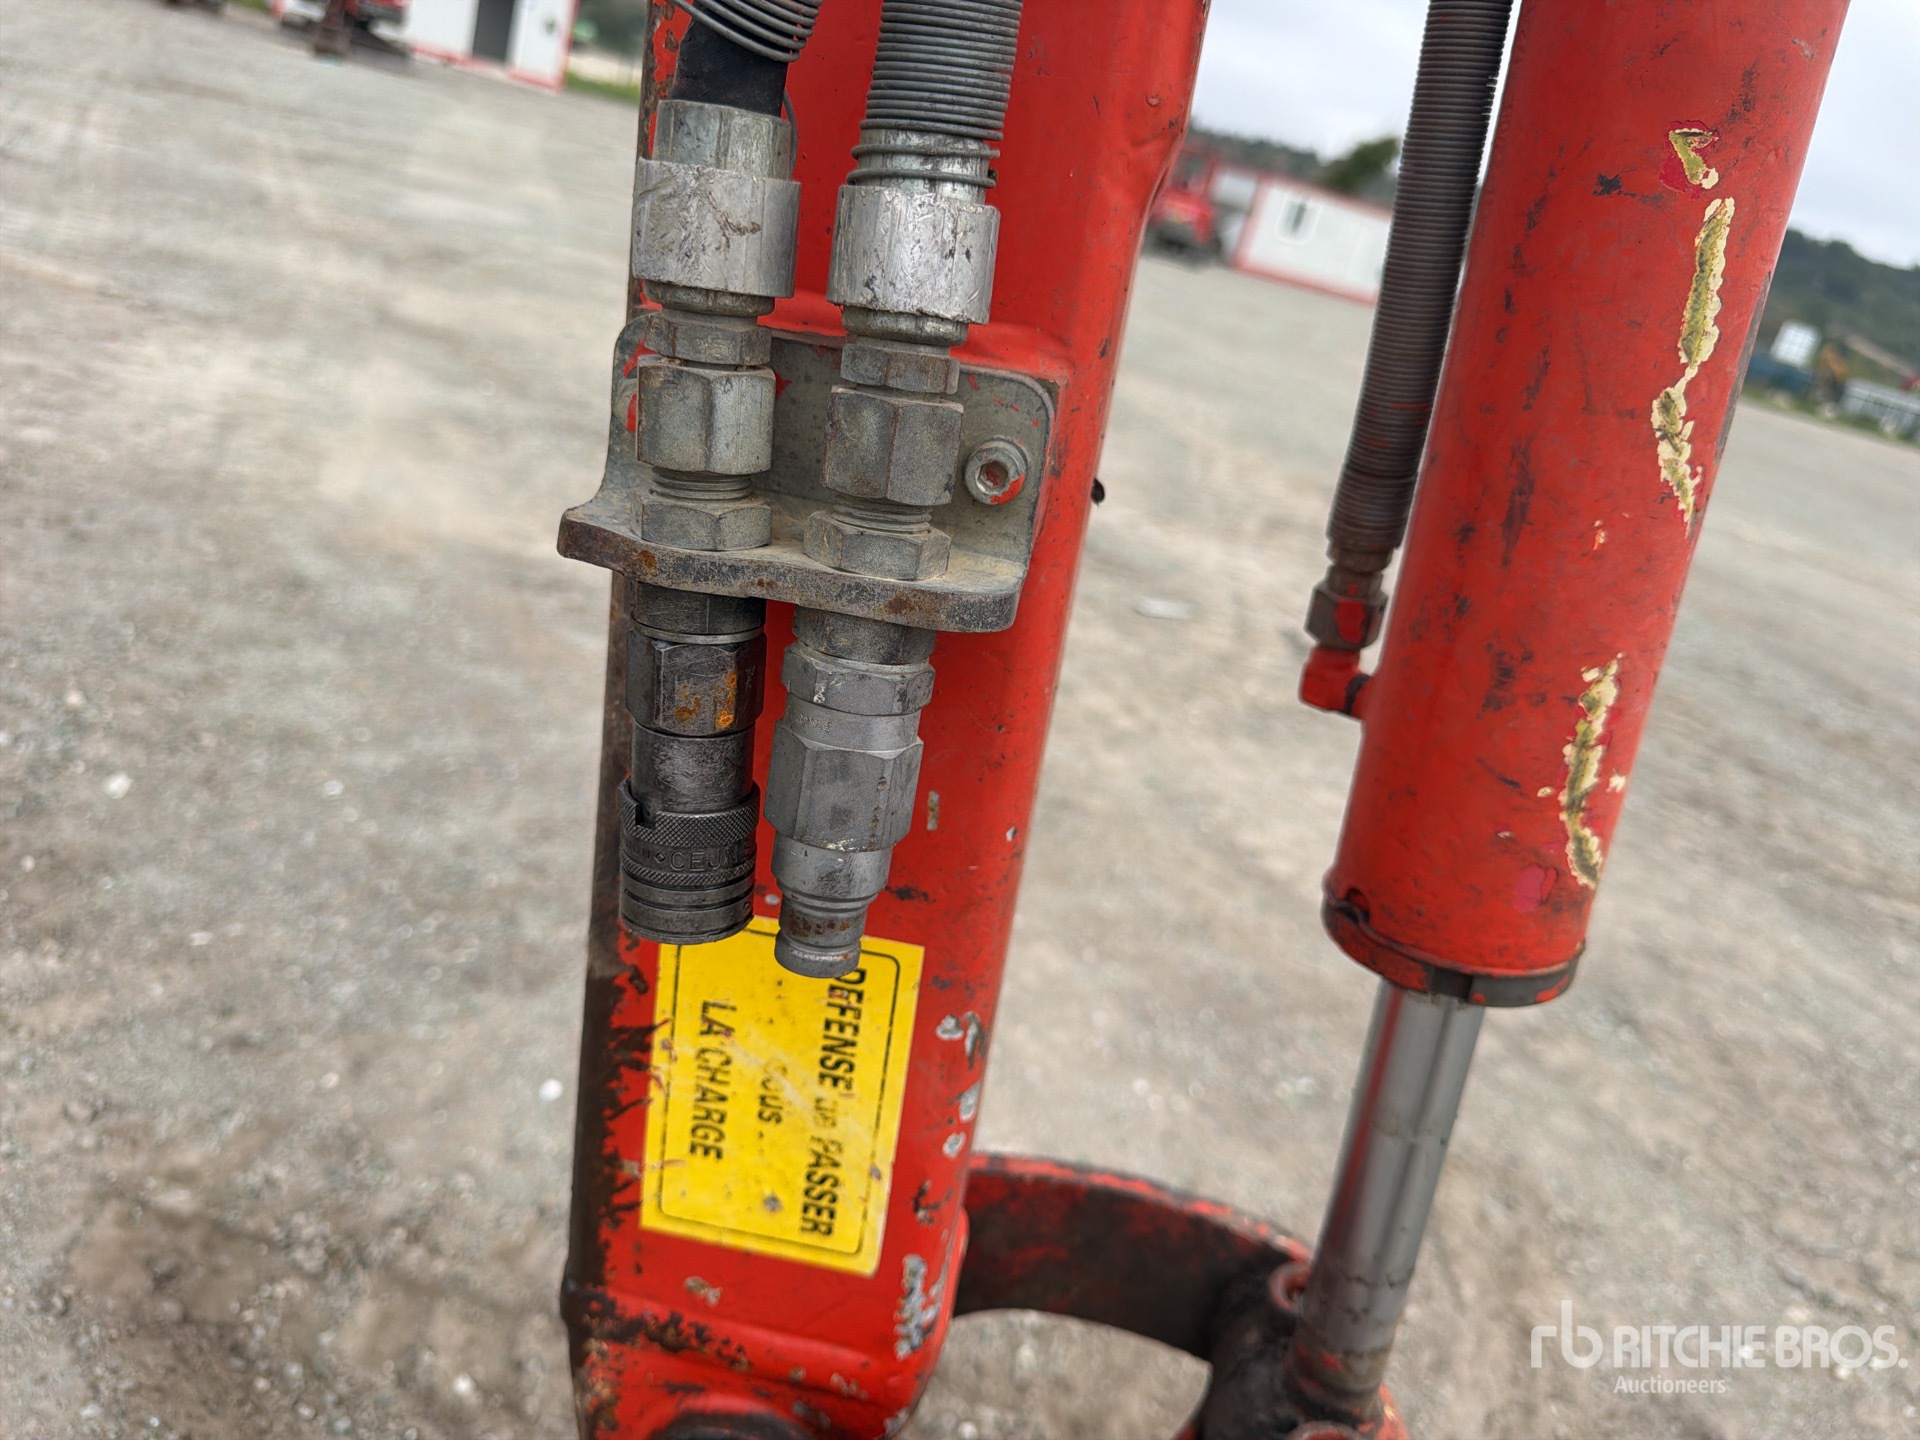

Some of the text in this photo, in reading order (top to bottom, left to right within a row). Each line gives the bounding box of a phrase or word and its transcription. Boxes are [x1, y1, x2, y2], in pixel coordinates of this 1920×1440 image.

[669, 846, 739, 872] CEJN
[689, 1000, 738, 1160] LA CHARGE
[818, 967, 867, 1090] DEFENSE
[799, 1134, 842, 1237] PASSER
